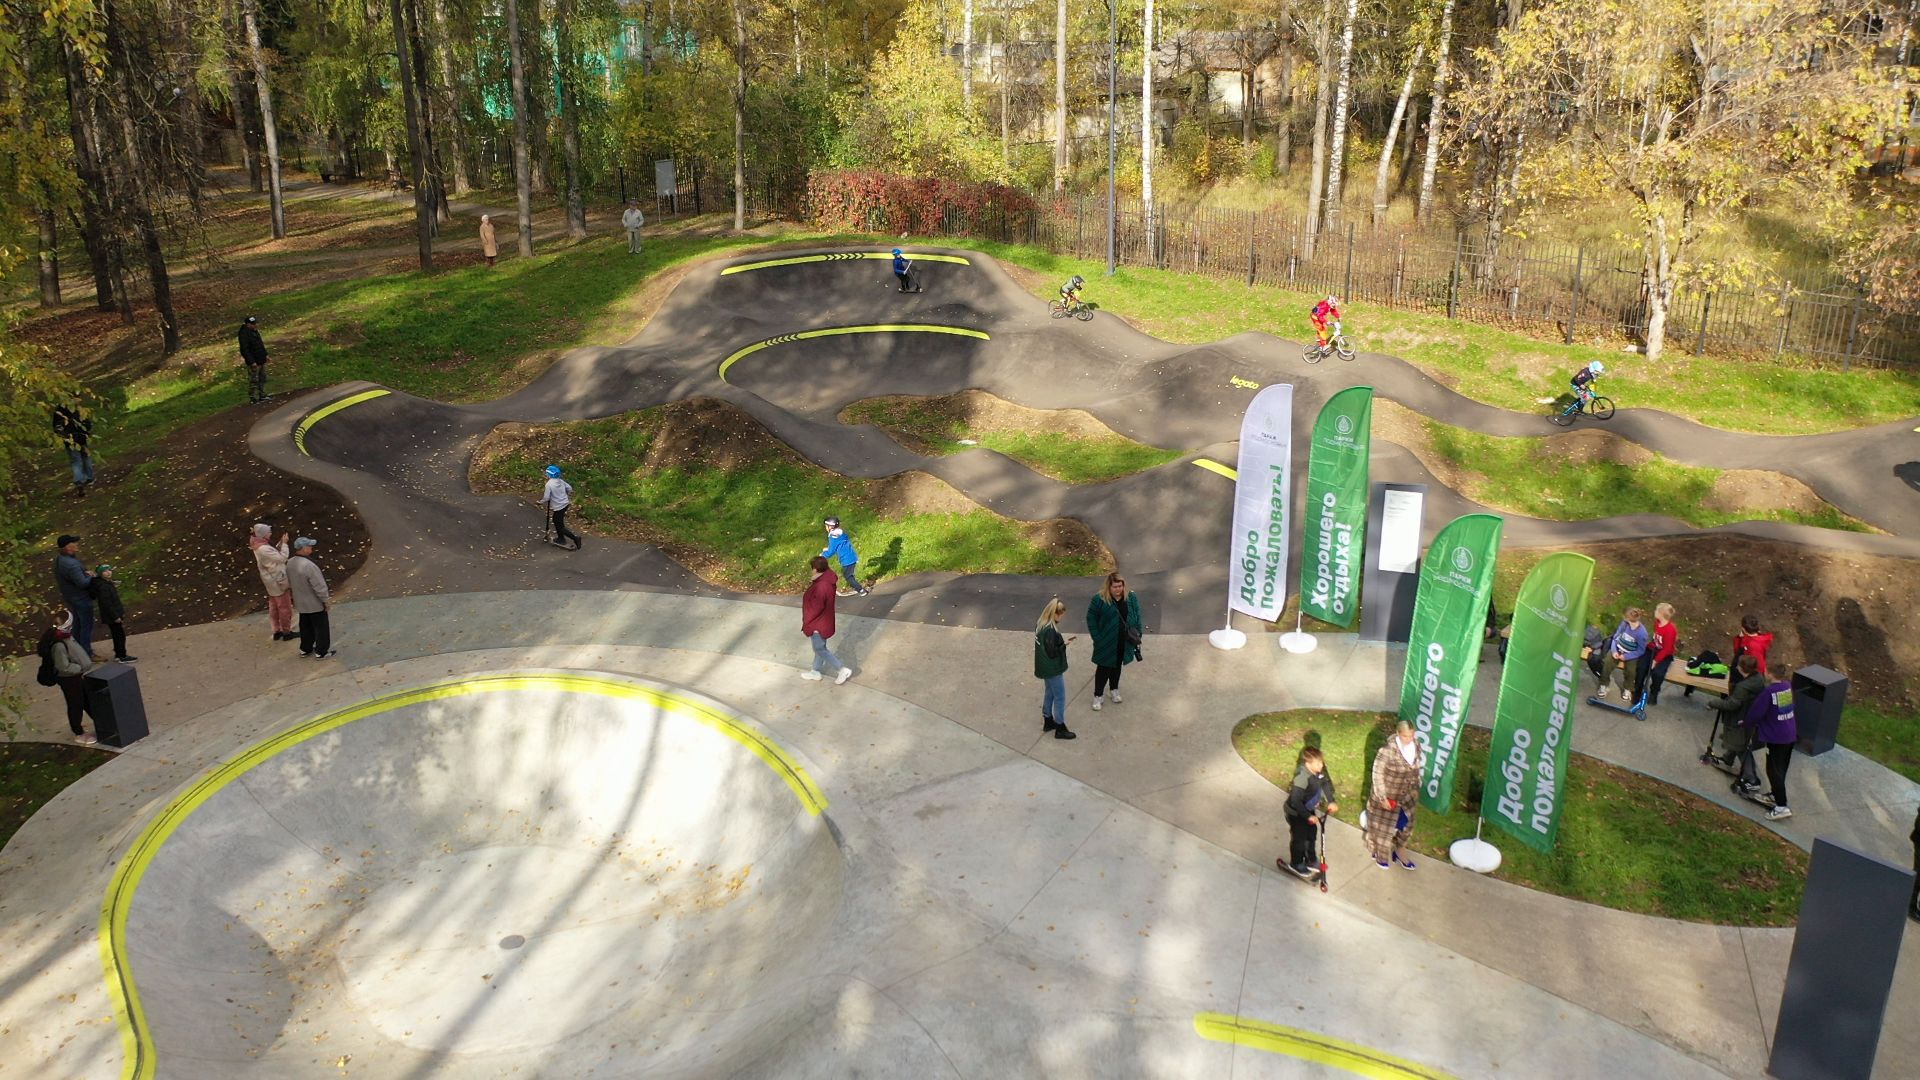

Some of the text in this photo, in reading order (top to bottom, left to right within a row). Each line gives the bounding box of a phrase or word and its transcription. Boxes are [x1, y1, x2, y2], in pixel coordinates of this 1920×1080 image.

[1241, 530, 1261, 607] Добро
[1311, 492, 1336, 610] Хорошего
[1333, 522, 1352, 615] отдыха!
[1497, 728, 1531, 824] Добро
[1531, 652, 1574, 834] пожаловать!
